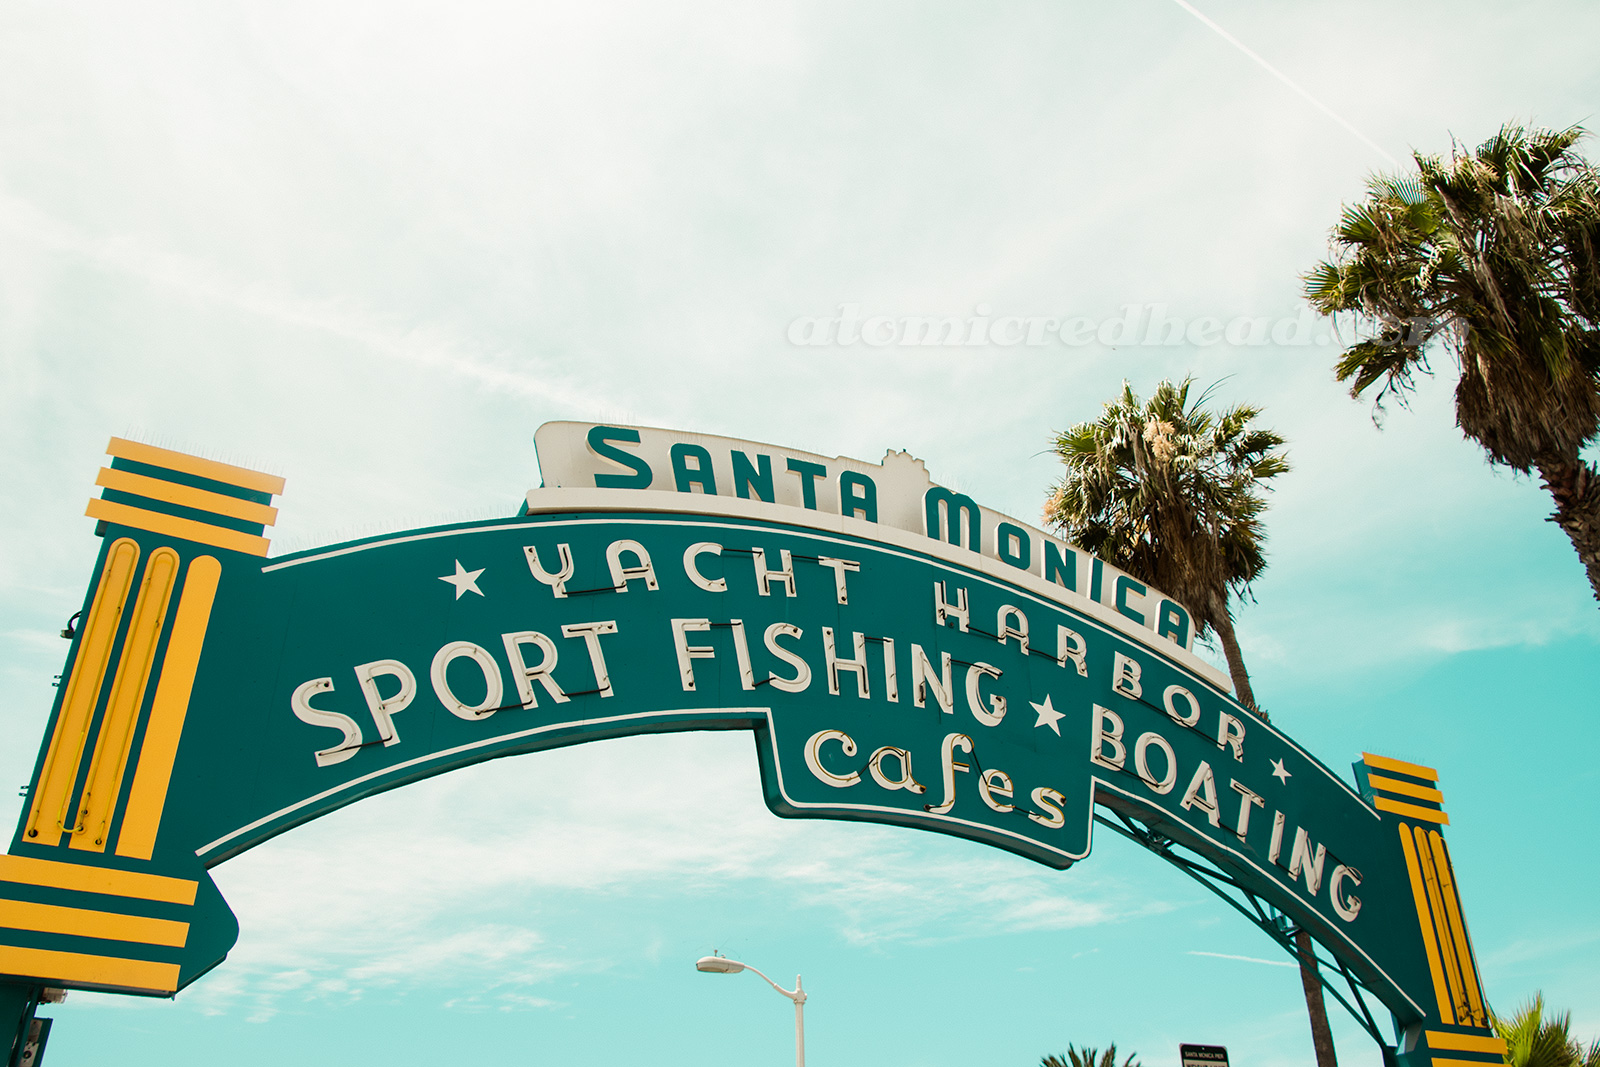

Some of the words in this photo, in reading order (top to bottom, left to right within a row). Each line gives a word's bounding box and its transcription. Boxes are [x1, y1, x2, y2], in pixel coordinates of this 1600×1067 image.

[523, 538, 861, 605] YACHT
[934, 580, 1246, 763] HARBOR
[586, 425, 878, 524] SANTA
[922, 486, 1194, 651] MONICA
[291, 620, 619, 767] SPORT
[670, 618, 1008, 727] FISHING
[1090, 703, 1364, 922] BOATING
[804, 729, 1067, 829] Cafes
